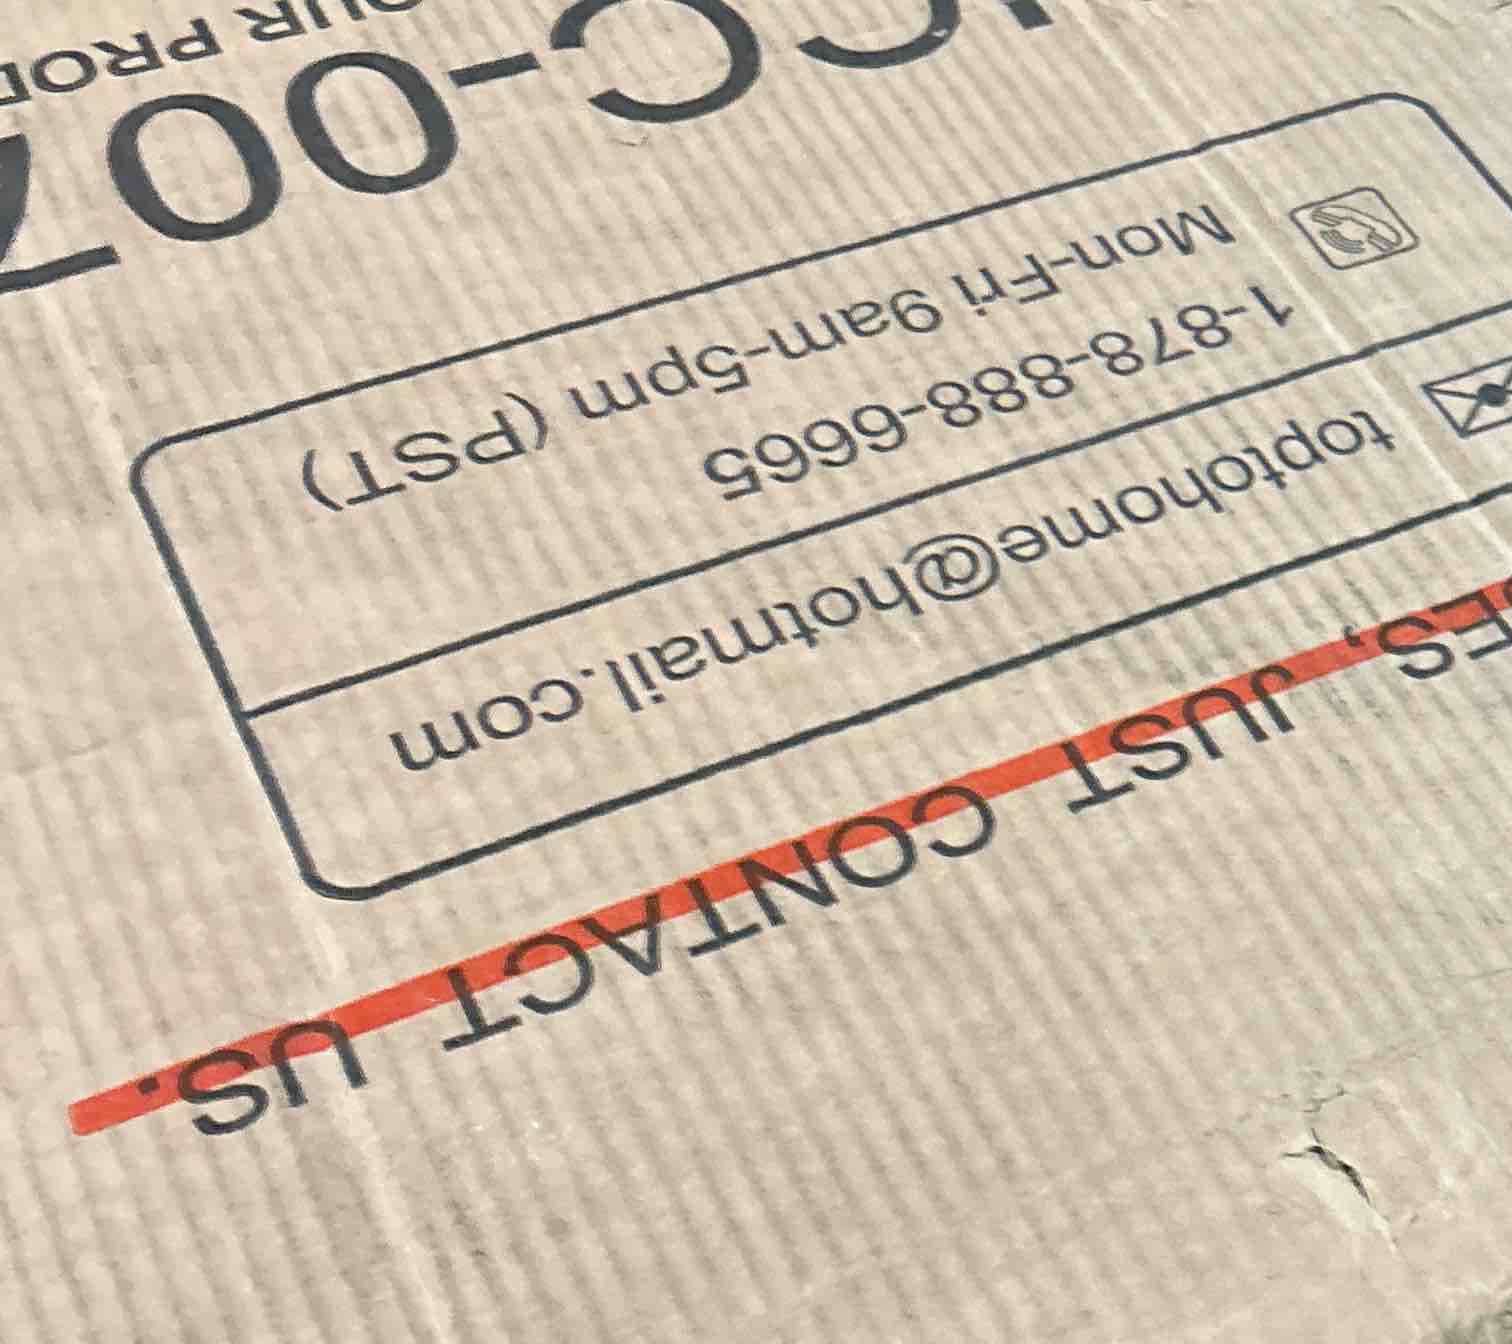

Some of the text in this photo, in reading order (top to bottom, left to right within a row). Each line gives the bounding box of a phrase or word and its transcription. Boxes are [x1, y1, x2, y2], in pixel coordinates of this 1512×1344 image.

[301, 203, 1236, 512] Mon-Fri 9am-5pm (PST)
[703, 284, 1294, 501] 1-878-888-6665
[389, 409, 1396, 771] toptohome@hotmail.com
[1066, 663, 1295, 814] JUST
[441, 784, 996, 1051] CONTACT
[137, 1018, 367, 1137] US.
